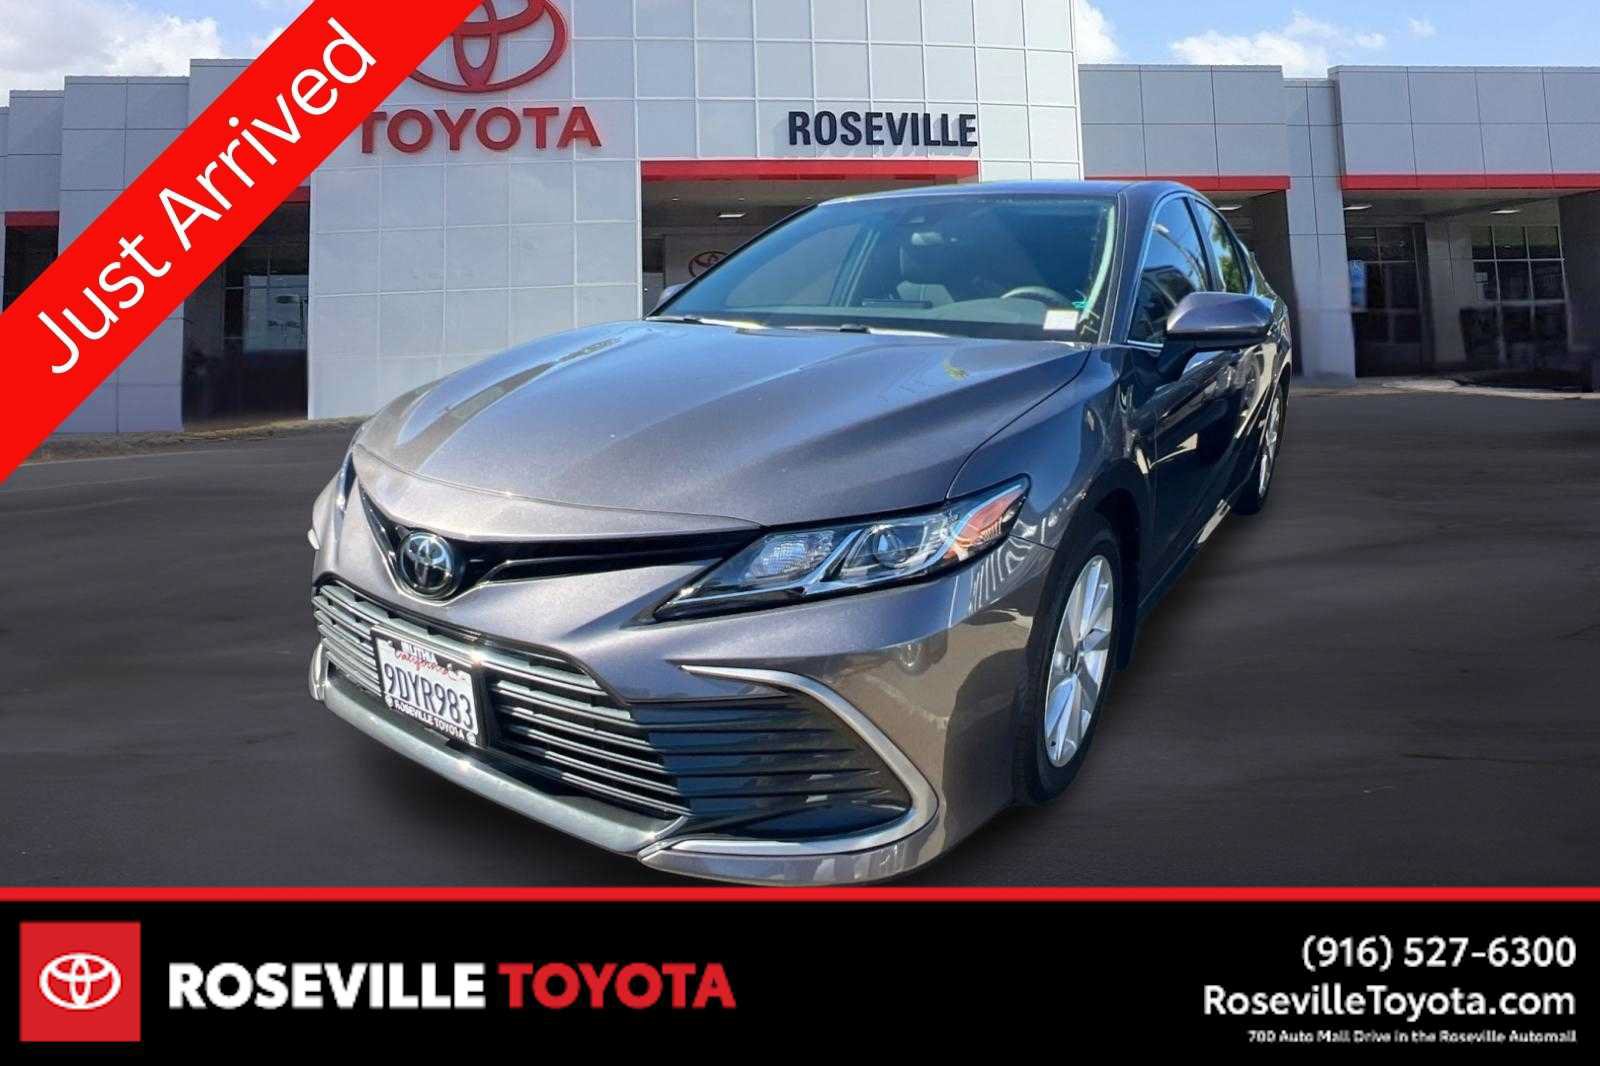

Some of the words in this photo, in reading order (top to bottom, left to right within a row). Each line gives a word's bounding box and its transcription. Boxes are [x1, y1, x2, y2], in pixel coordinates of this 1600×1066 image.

[361, 106, 602, 154] TOYOTA
[788, 110, 978, 147] ROSEVILLE
[384, 662, 474, 730] 9DYR983
